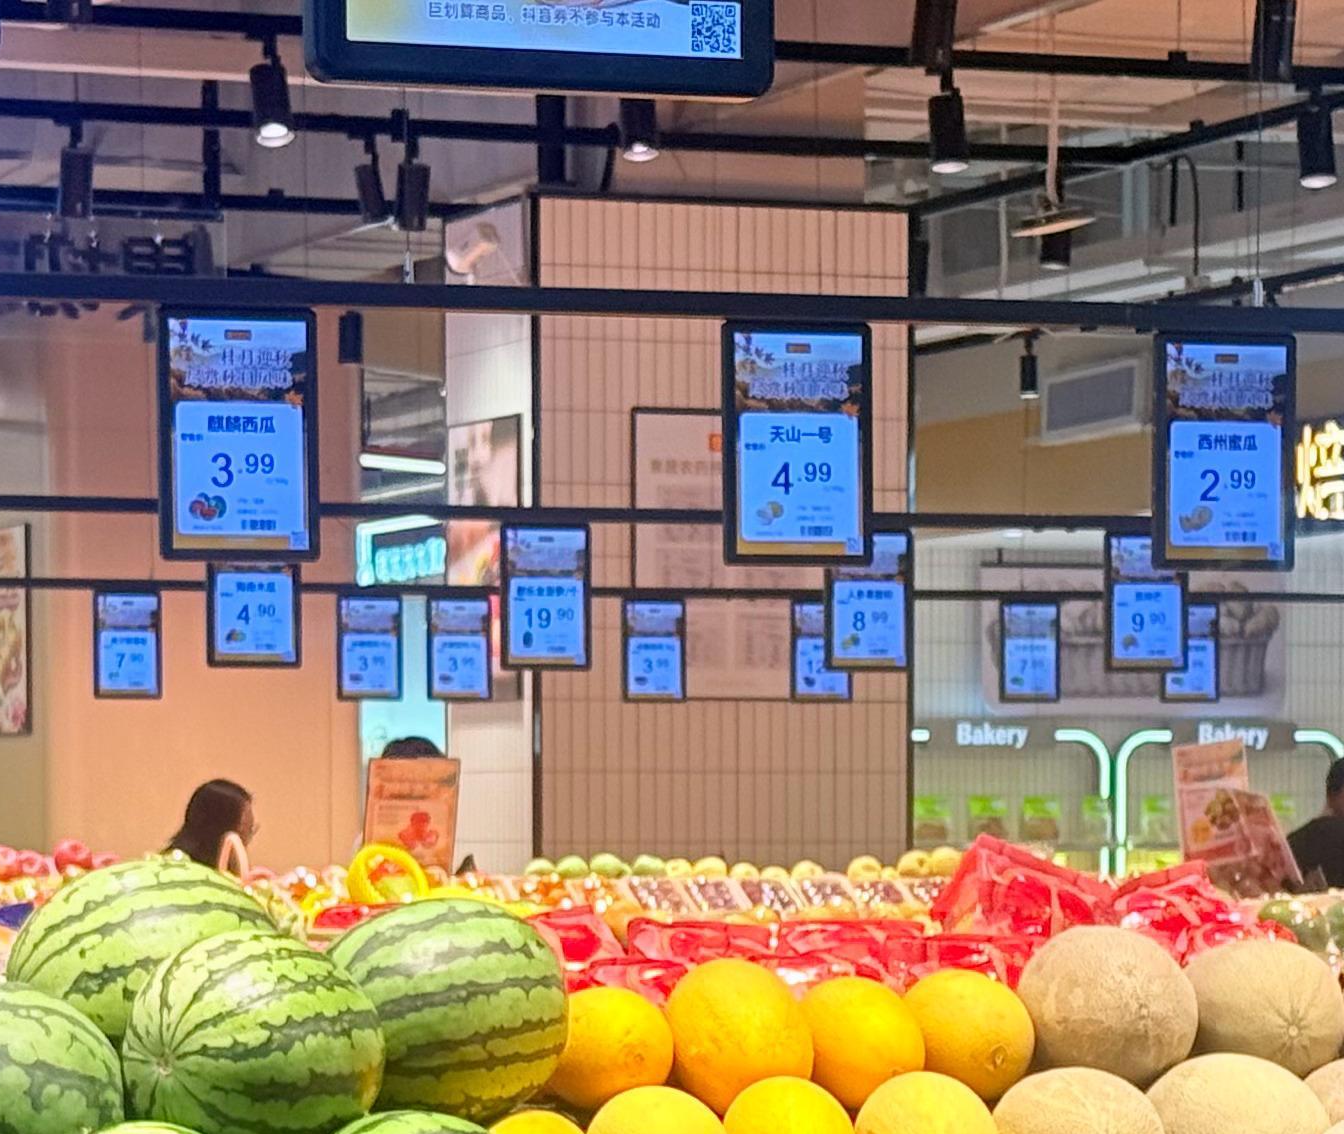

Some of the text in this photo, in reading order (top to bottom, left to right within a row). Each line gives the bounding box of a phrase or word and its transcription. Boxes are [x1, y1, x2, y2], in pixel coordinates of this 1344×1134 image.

[770, 426, 832, 443] 天山一号
[211, 453, 274, 487] 3.99
[771, 462, 832, 495] 4.99
[1200, 469, 1256, 502] 2.99
[956, 720, 1029, 748] Bakery
